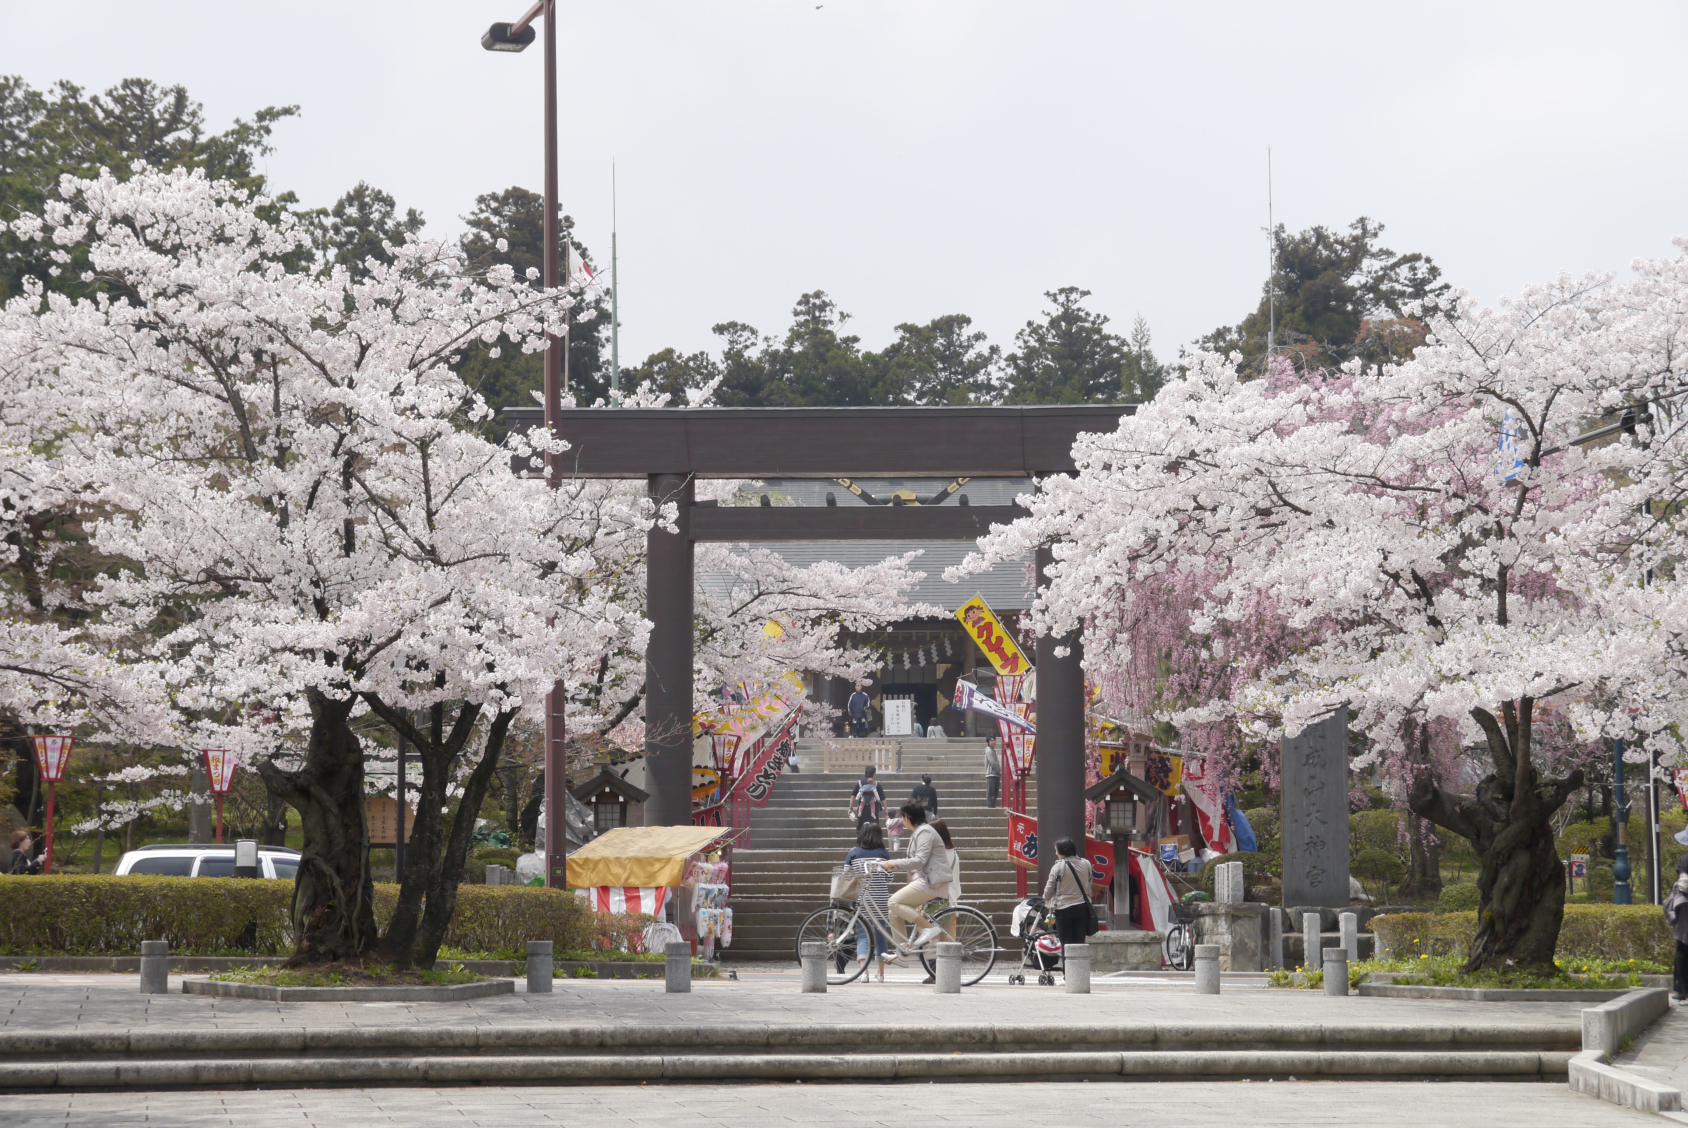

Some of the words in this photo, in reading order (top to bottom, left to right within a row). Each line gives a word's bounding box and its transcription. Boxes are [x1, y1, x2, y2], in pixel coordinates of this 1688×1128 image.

[976, 621, 1020, 674] クレープ
[724, 738, 735, 765] 桜まつり
[1024, 738, 1033, 764] 桜まつり
[210, 754, 221, 786] 桜まつり
[744, 738, 790, 801] 焼きとり
[1013, 822, 1025, 852] 元祖
